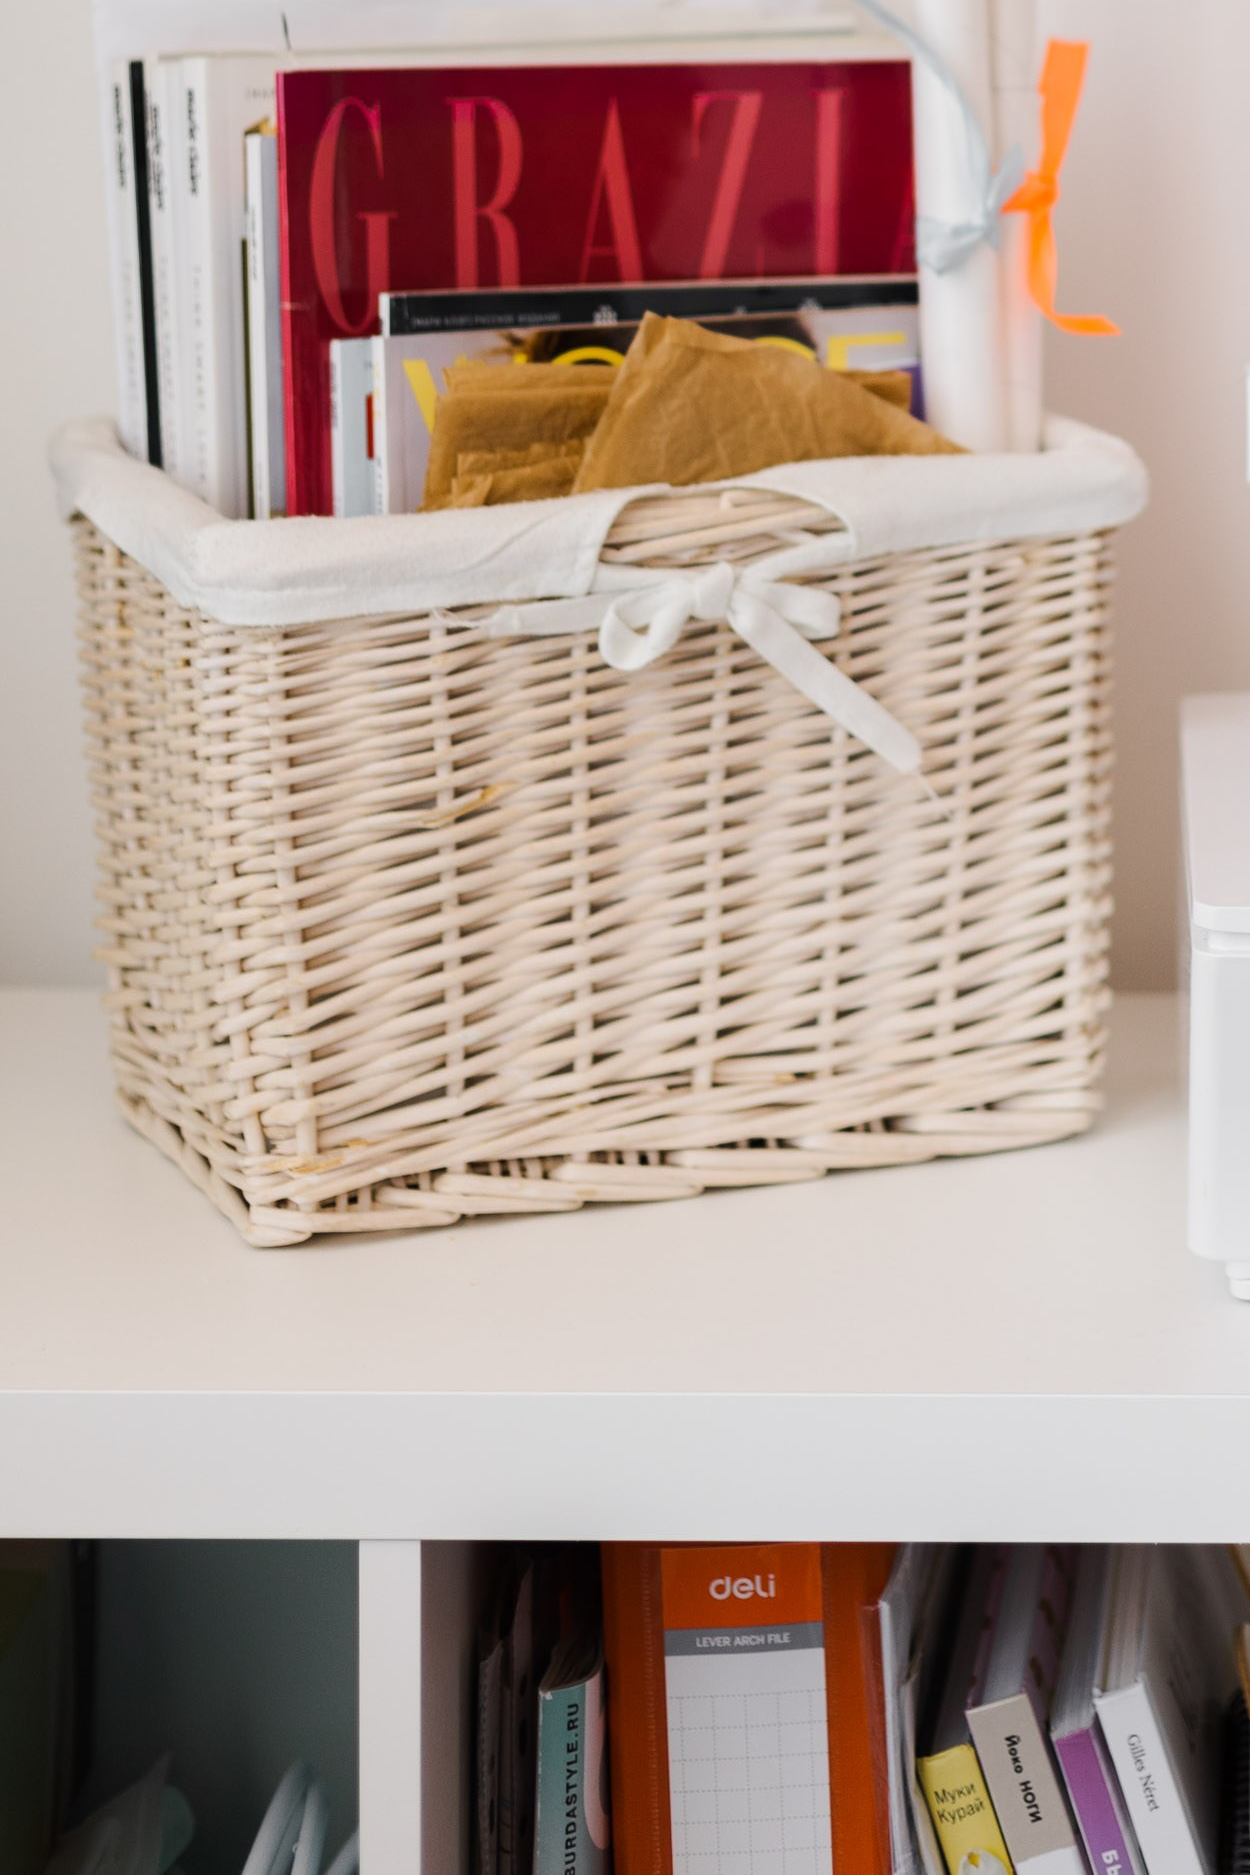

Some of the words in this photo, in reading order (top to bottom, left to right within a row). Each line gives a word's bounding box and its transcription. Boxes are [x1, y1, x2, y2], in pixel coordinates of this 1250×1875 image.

[308, 88, 914, 334] GRAZI
[708, 1572, 776, 1601] deli
[695, 1636, 732, 1648] LEVER
[733, 1634, 766, 1647] ARCH
[766, 1632, 791, 1644] FILE
[1004, 1734, 1025, 1775] Йоко
[564, 1702, 581, 1875] BURDASTYLE.RU
[1127, 1733, 1147, 1773] Gilles
[1139, 1774, 1160, 1812] Néret
[933, 1782, 977, 1806] Муки
[936, 1797, 986, 1825] Курай
